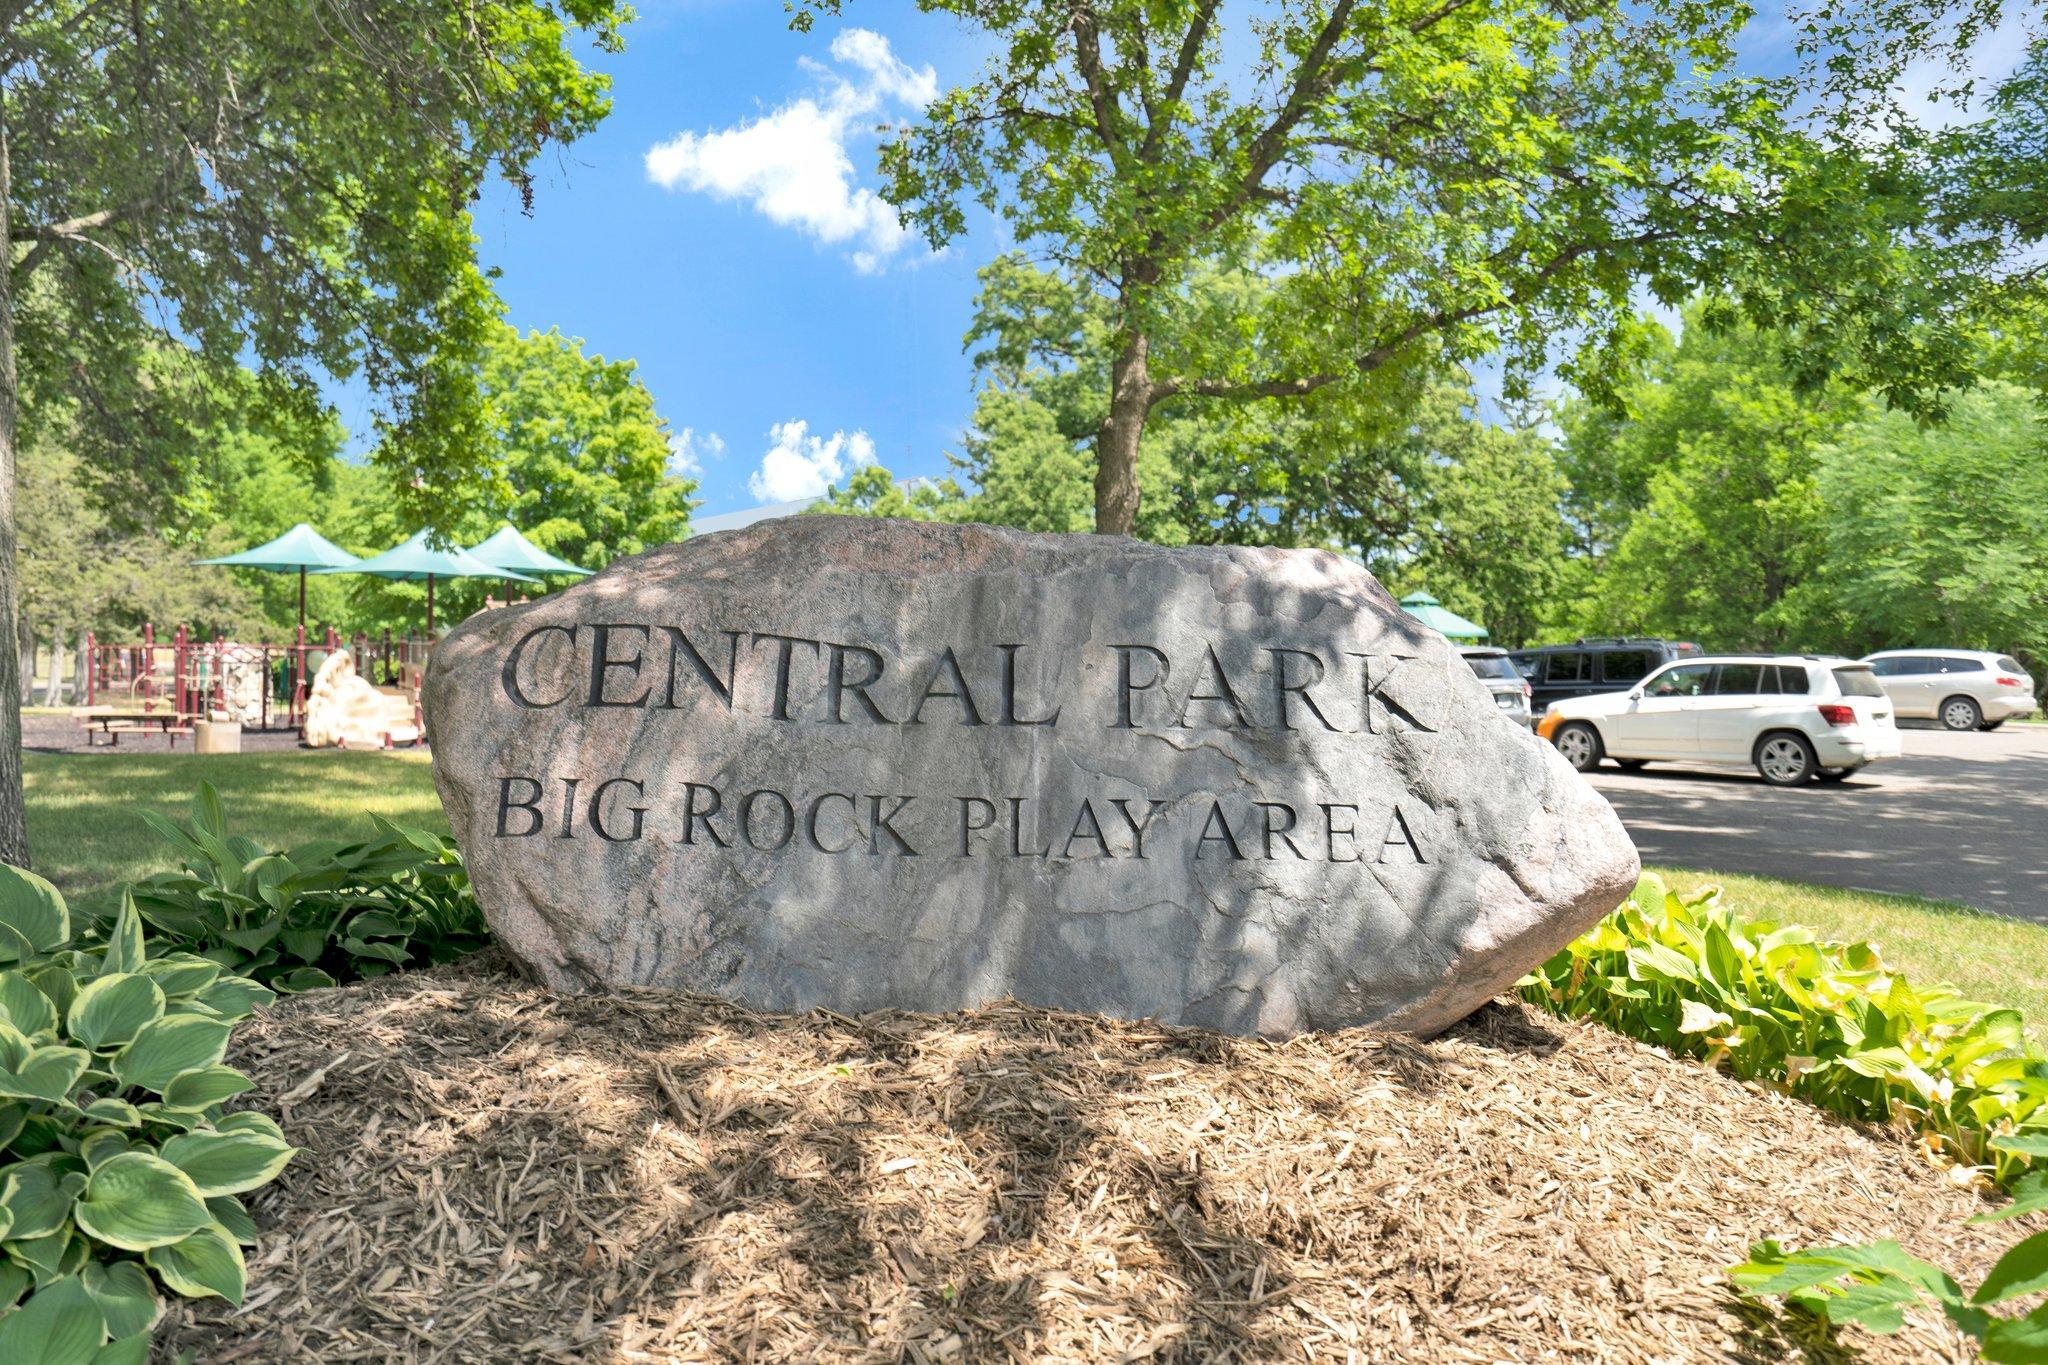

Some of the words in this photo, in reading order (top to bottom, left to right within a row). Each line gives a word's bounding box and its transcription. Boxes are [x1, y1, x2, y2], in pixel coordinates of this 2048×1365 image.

[501, 622, 1062, 727] CENTRAL
[1106, 643, 1438, 735] PARK
[494, 776, 649, 843] BIG
[675, 781, 924, 858] ROCK
[953, 796, 1167, 859] PLAY
[1196, 799, 1430, 864] AREA
